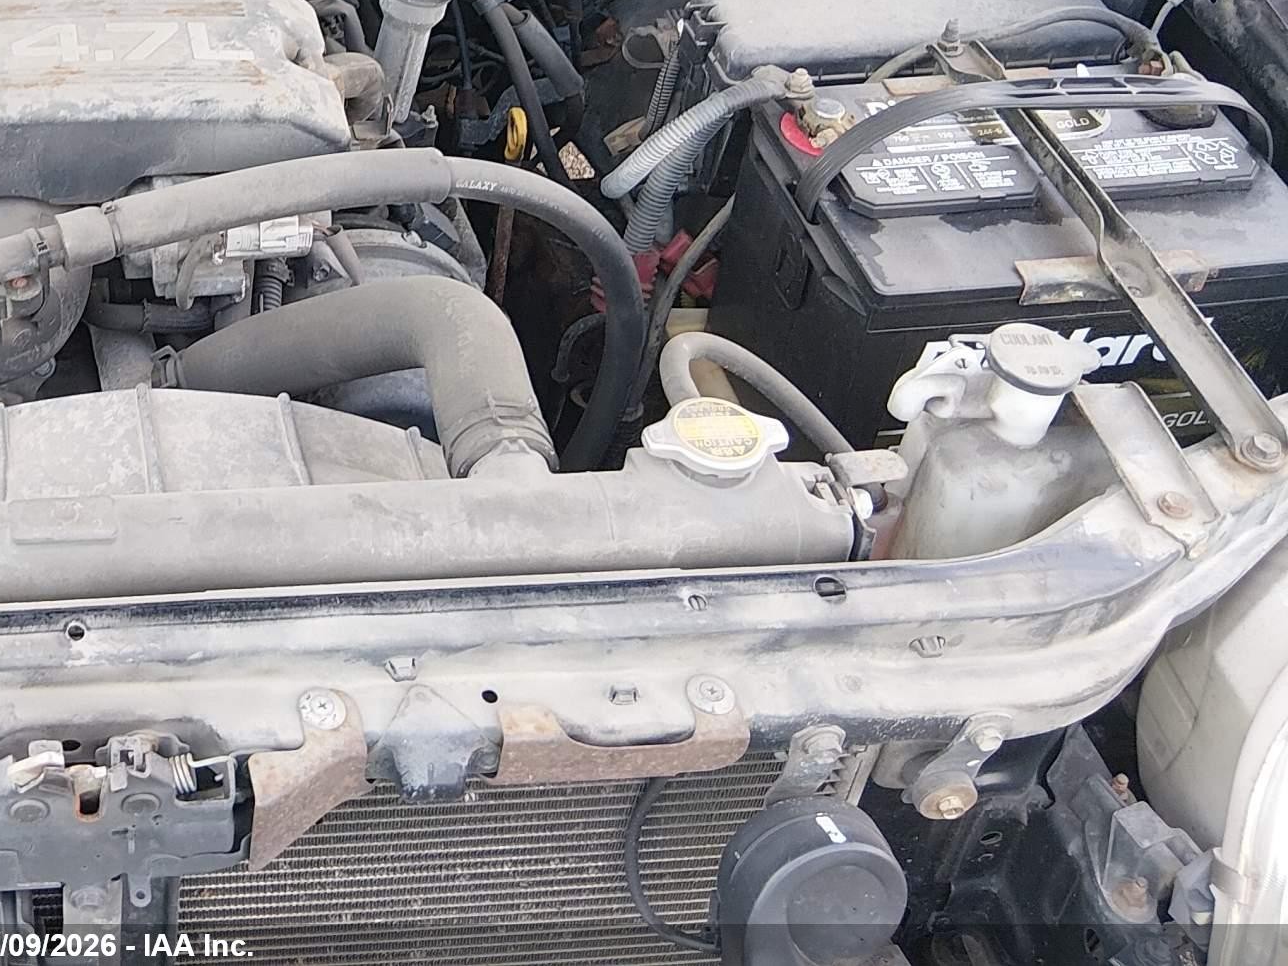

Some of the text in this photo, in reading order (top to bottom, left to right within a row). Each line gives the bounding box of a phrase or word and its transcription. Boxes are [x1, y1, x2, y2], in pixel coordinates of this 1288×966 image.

[11, 21, 256, 63] 4.7L
[1056, 117, 1091, 130] GOLD
[883, 154, 931, 167] DANGER
[941, 150, 987, 162] POISON
[456, 179, 498, 191] GALAXY
[1163, 410, 1210, 429] GOL
